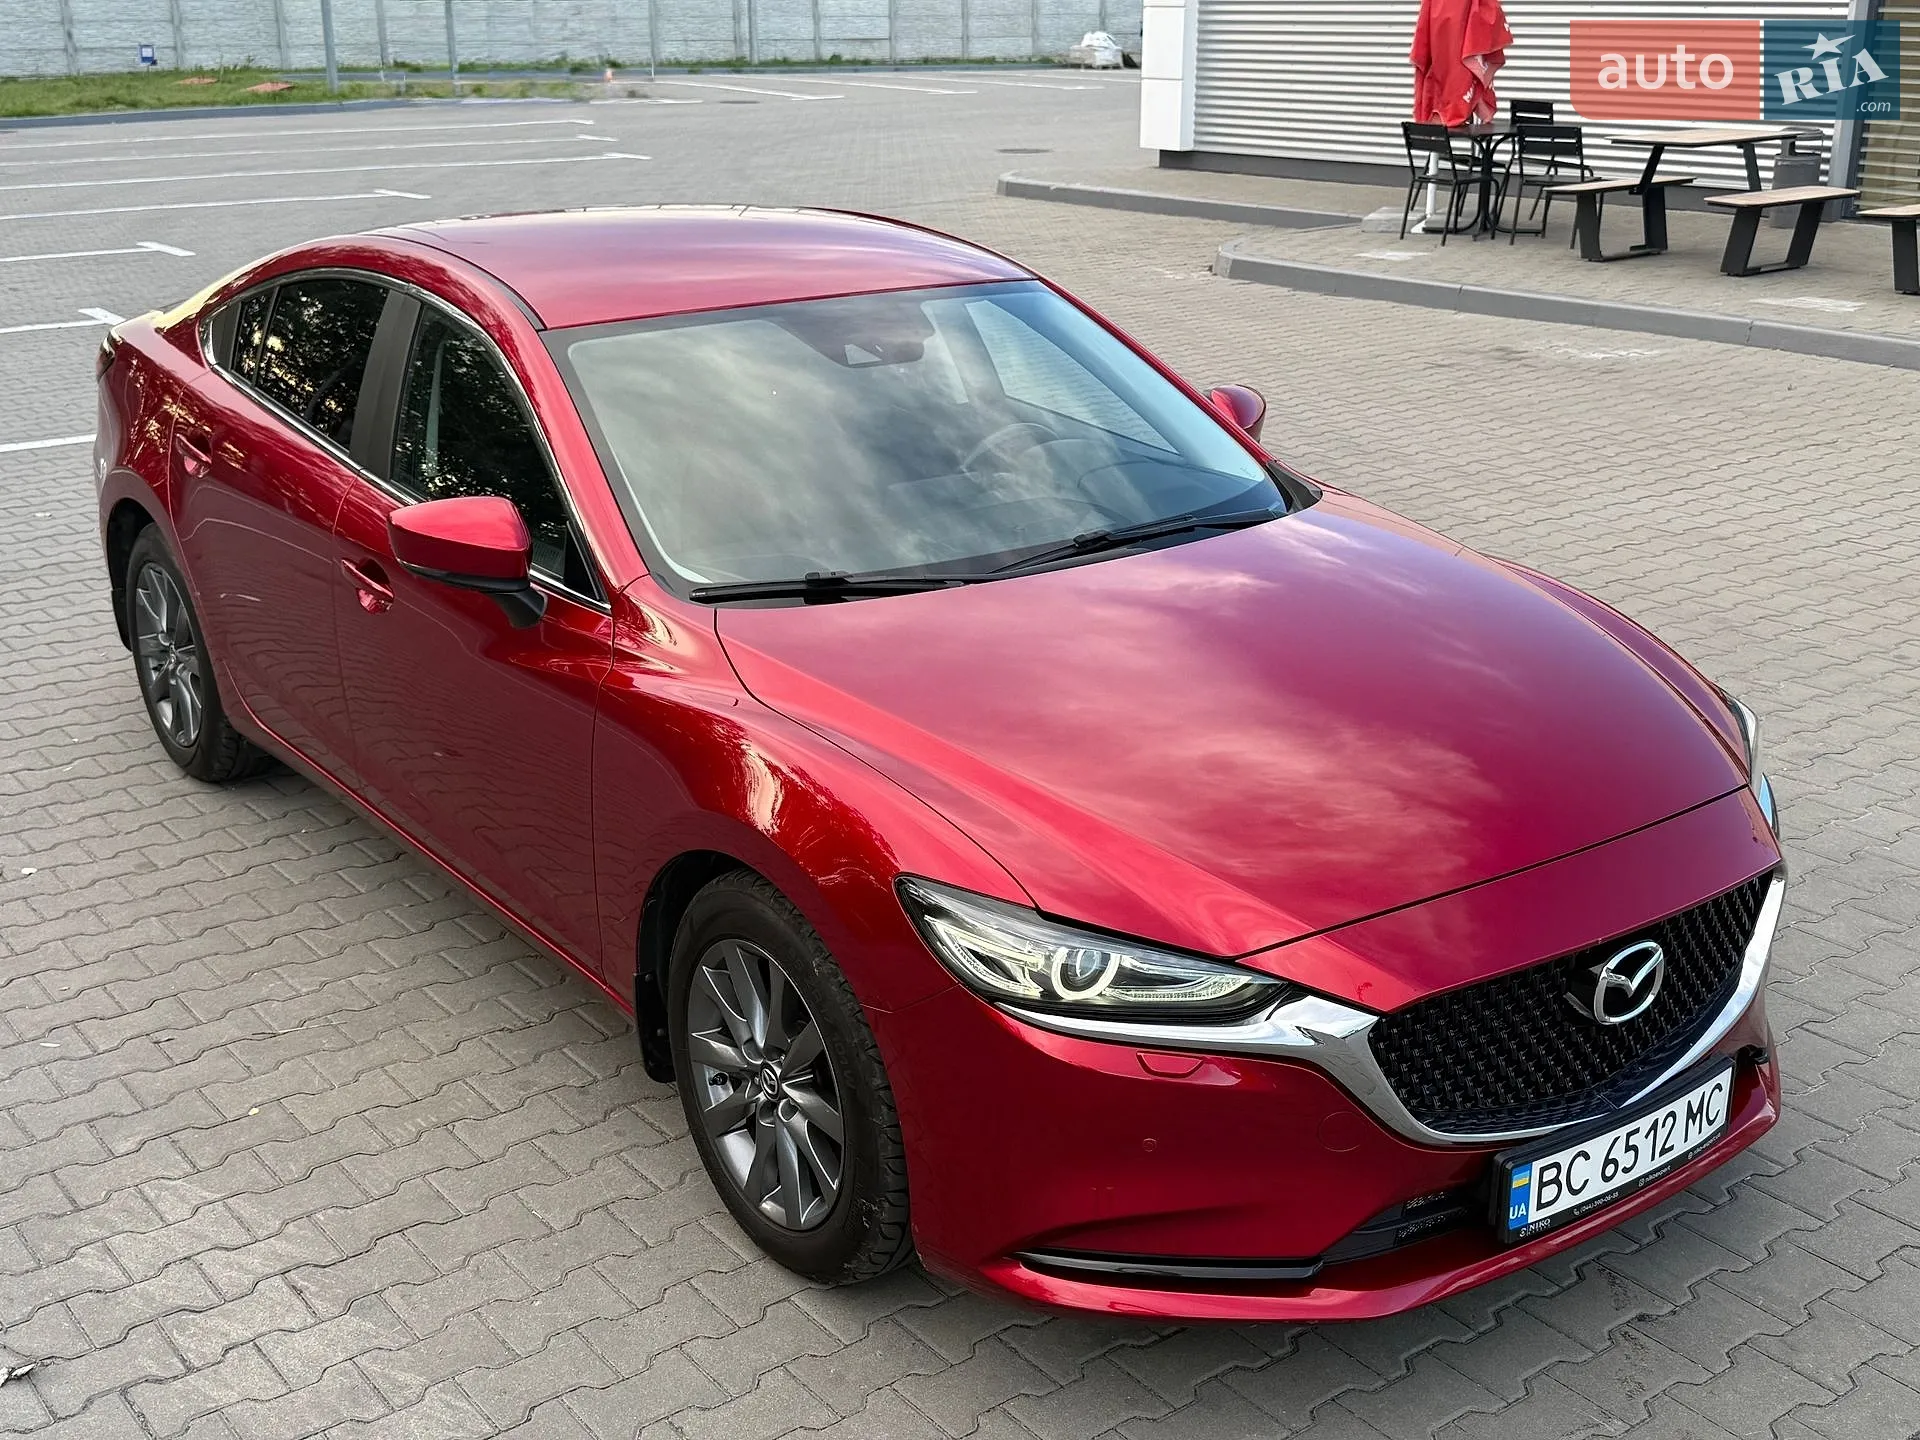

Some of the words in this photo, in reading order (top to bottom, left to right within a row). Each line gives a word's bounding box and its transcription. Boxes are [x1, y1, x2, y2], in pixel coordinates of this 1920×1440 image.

[1536, 1150, 1591, 1212] BC
[1600, 1110, 1677, 1183] 6512
[1684, 1082, 1723, 1143] MC
[1509, 1202, 1526, 1220] UA
[1529, 1218, 1551, 1232] NIKO
